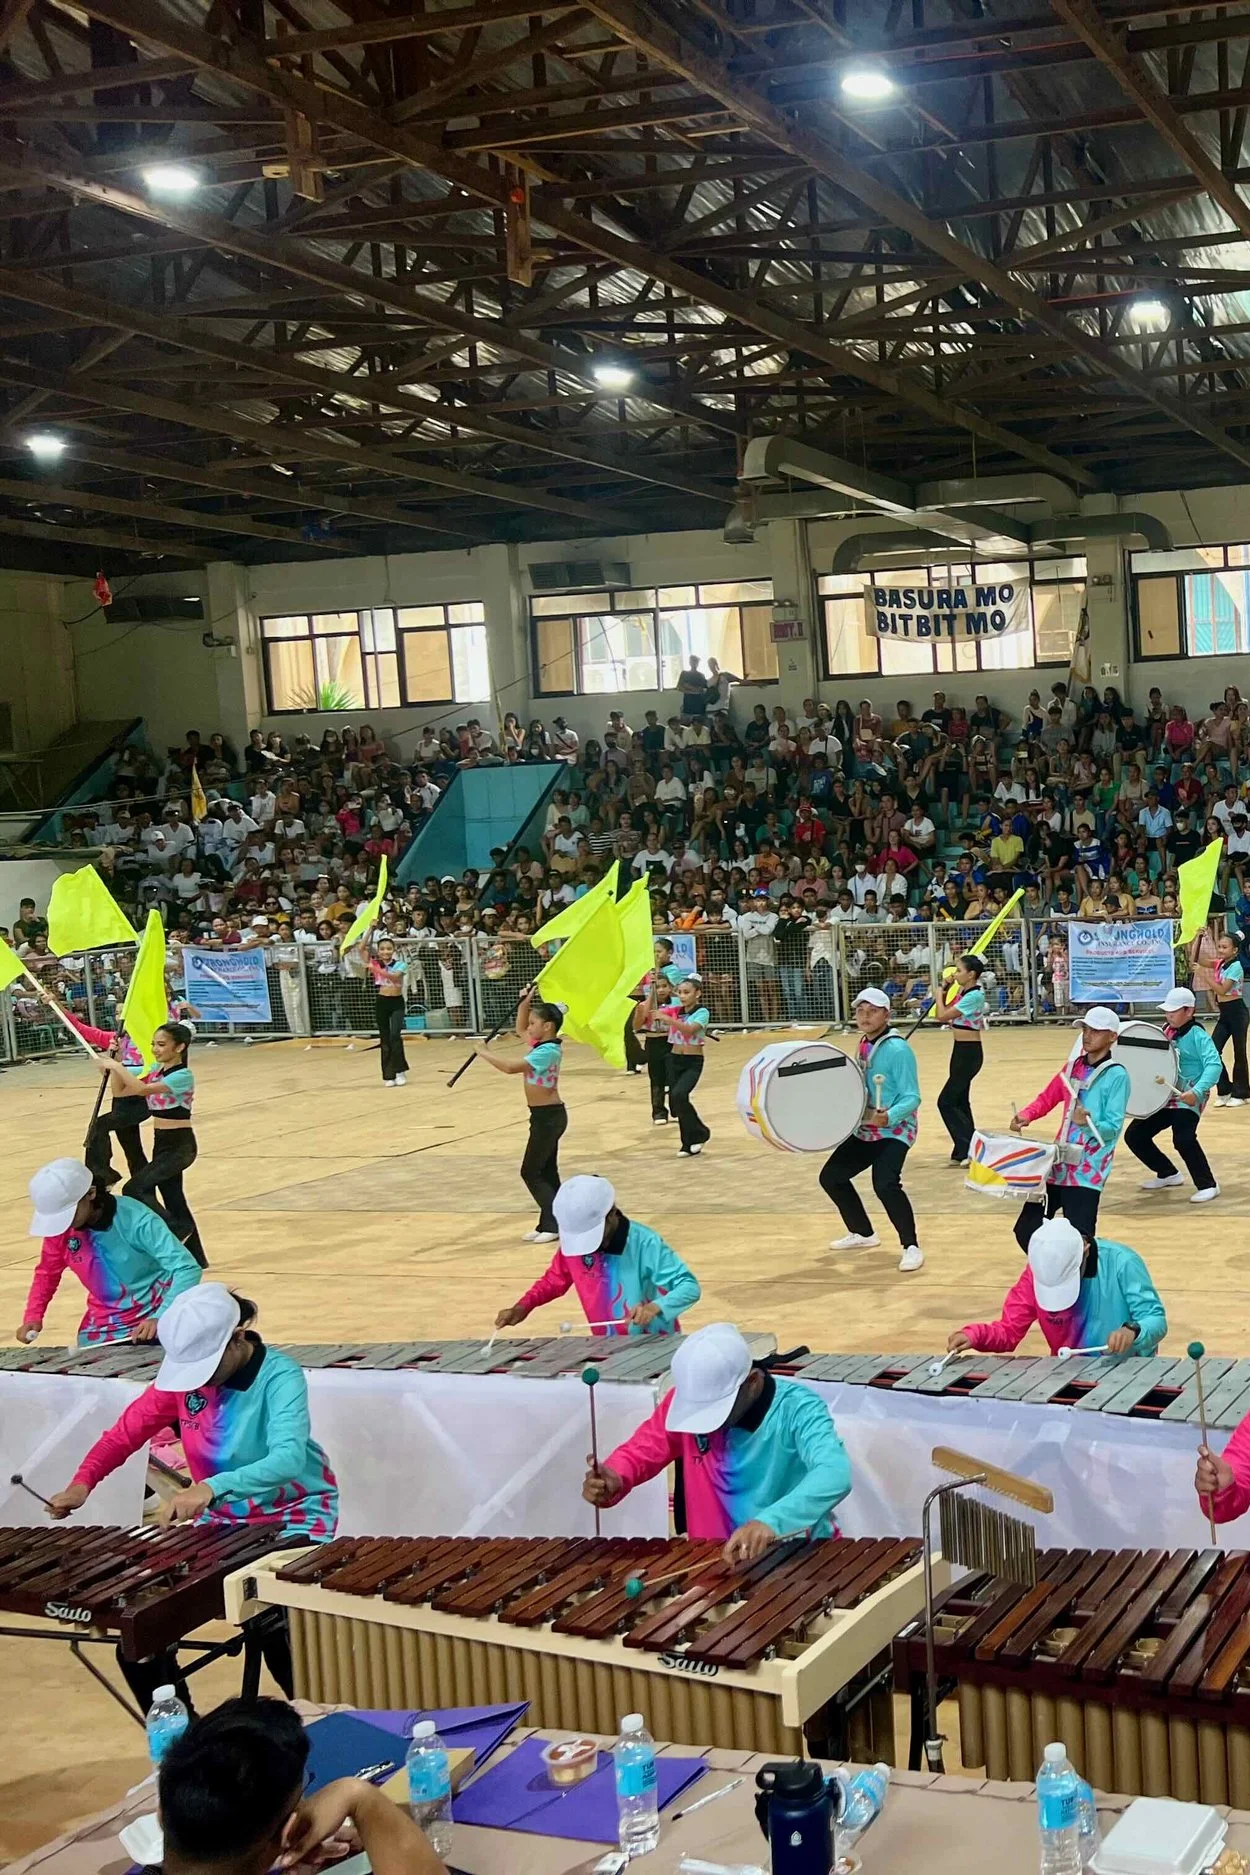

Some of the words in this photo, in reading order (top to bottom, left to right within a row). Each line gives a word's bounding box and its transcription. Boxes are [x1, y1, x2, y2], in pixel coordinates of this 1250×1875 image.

[873, 587, 968, 610] BASURA
[975, 584, 1014, 607] MO
[877, 610, 958, 637] BITBIT
[965, 610, 1007, 635] MO
[1094, 928, 1164, 941] SONGHOLD
